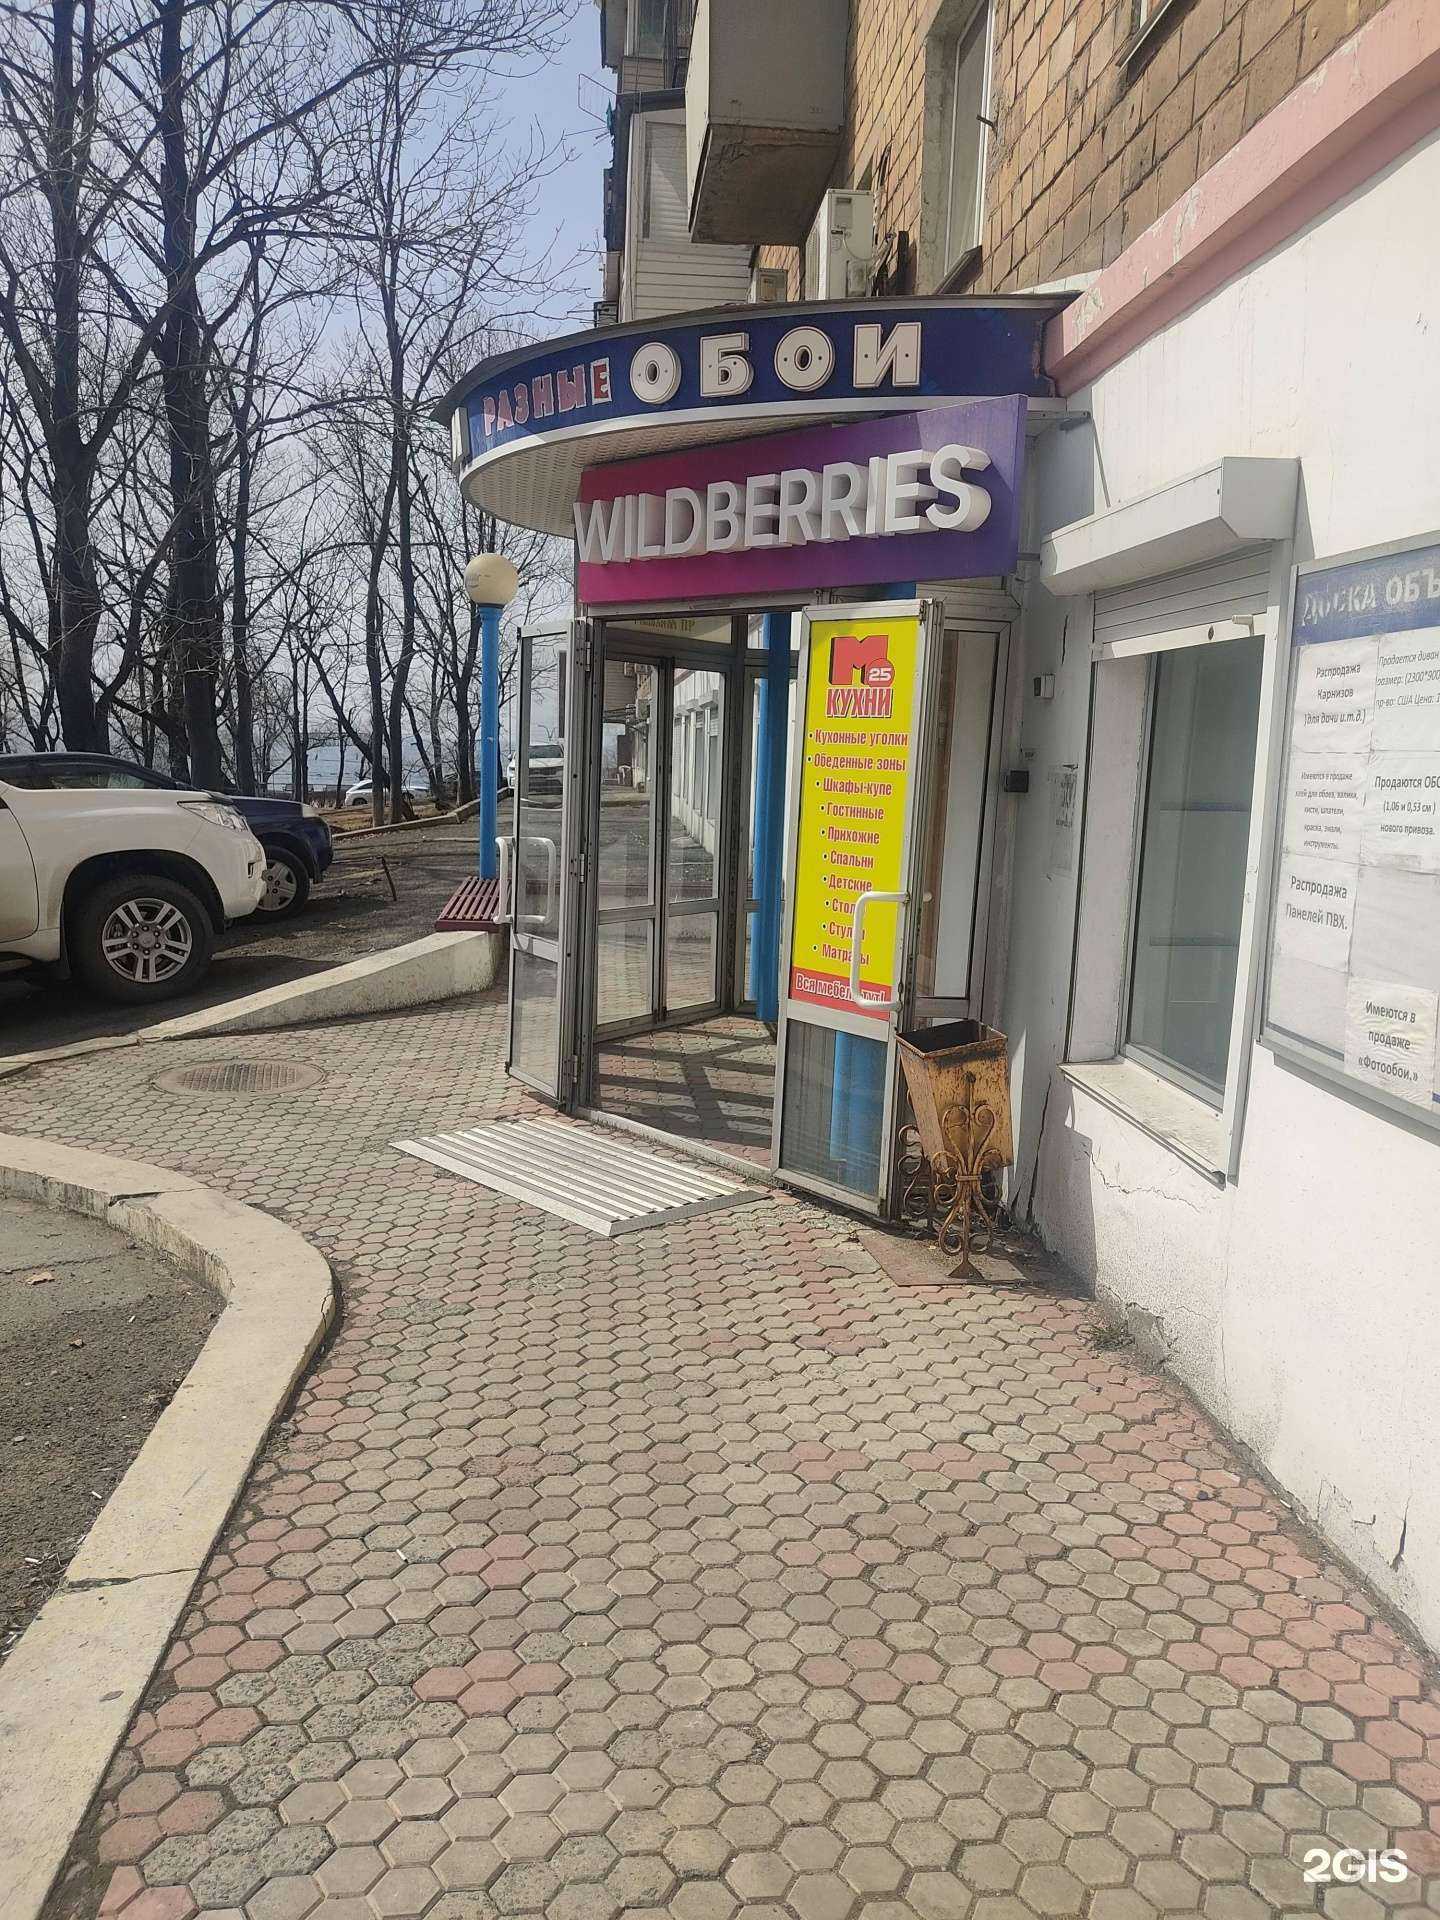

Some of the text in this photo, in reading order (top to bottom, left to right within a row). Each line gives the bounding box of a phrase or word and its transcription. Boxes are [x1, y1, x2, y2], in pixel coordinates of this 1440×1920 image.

[482, 322, 922, 438] РАЗНЫЕ ОБОИ
[573, 443, 991, 564] WILDBERRIES
[1316, 664, 1361, 679] Распродажа
[826, 687, 893, 718] КУХНИ
[815, 729, 909, 747] Кухонные уголки
[814, 754, 906, 772] Обеденные зоны
[823, 778, 892, 796] Шкафы-купе
[1374, 776, 1422, 790] Продаются
[828, 826, 880, 845] Прихожие
[1380, 824, 1403, 834] нового
[830, 850, 874, 869] Спальни
[829, 874, 872, 892] Детские
[1290, 875, 1347, 899] Распродажа
[832, 898, 866, 915] Стол
[1286, 903, 1349, 931] Панелей ПВХ.
[822, 943, 870, 966] Матраы
[796, 973, 817, 995] Вся
[816, 979, 856, 1003] мебел
[1365, 1001, 1416, 1024] Имеются в
[1368, 1030, 1411, 1050] продаже
